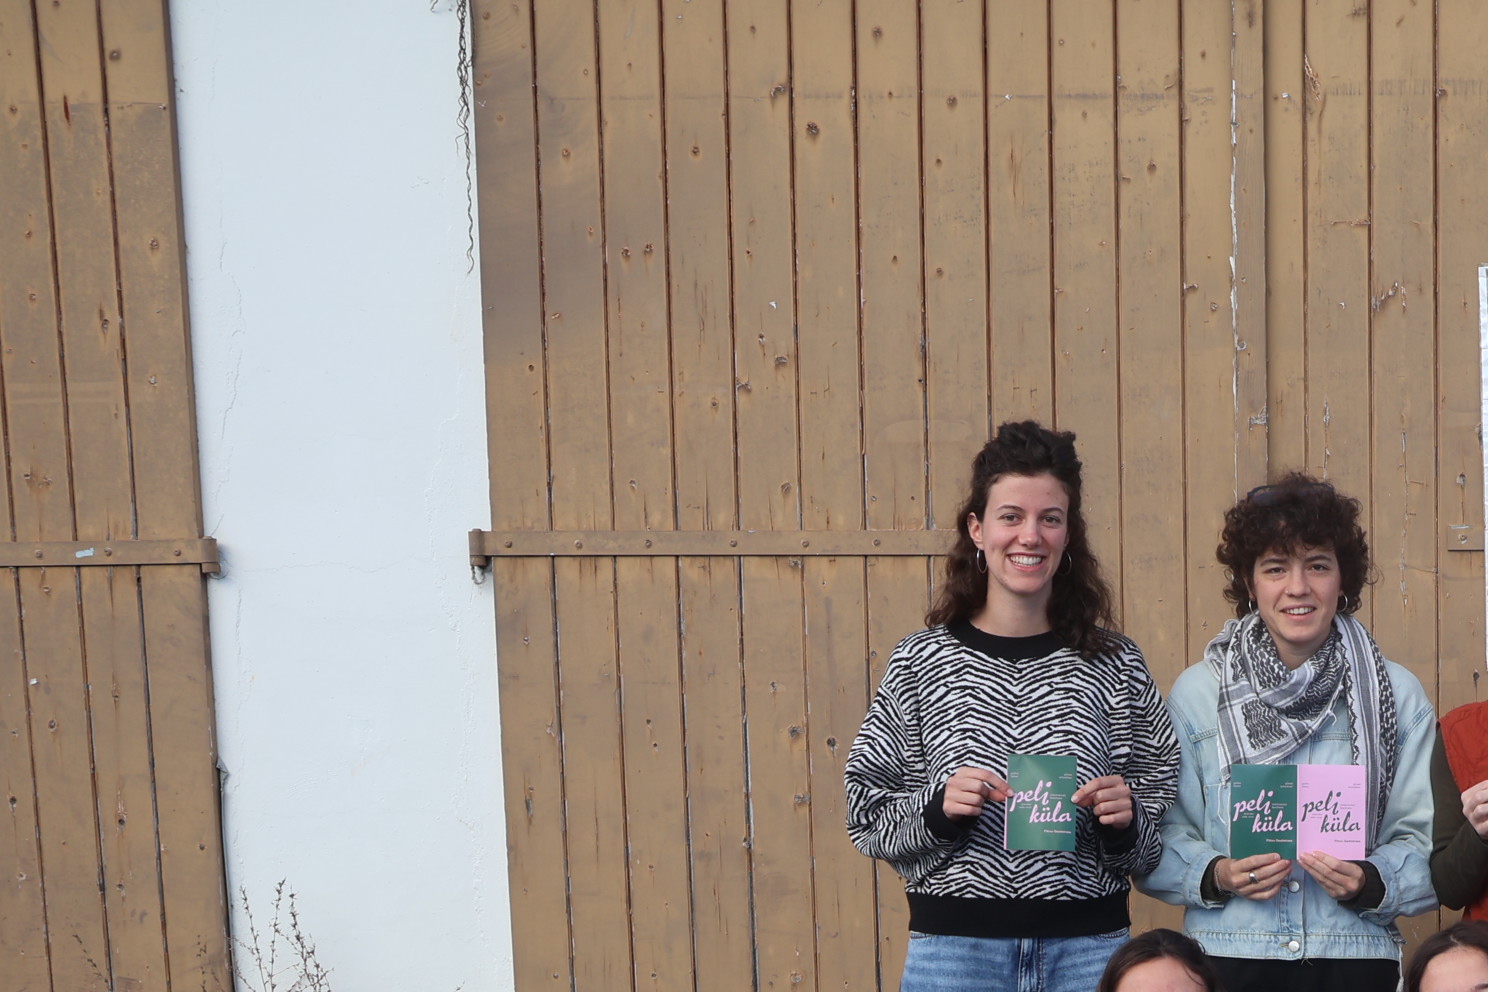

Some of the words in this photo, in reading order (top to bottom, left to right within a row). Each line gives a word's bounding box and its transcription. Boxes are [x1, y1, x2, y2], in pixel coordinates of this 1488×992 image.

[1009, 779, 1052, 812] peli
[1232, 789, 1274, 822] peli
[1301, 790, 1342, 822] peli
[1029, 801, 1072, 823] küla
[1252, 810, 1293, 833] küla
[1320, 811, 1361, 833] küla
